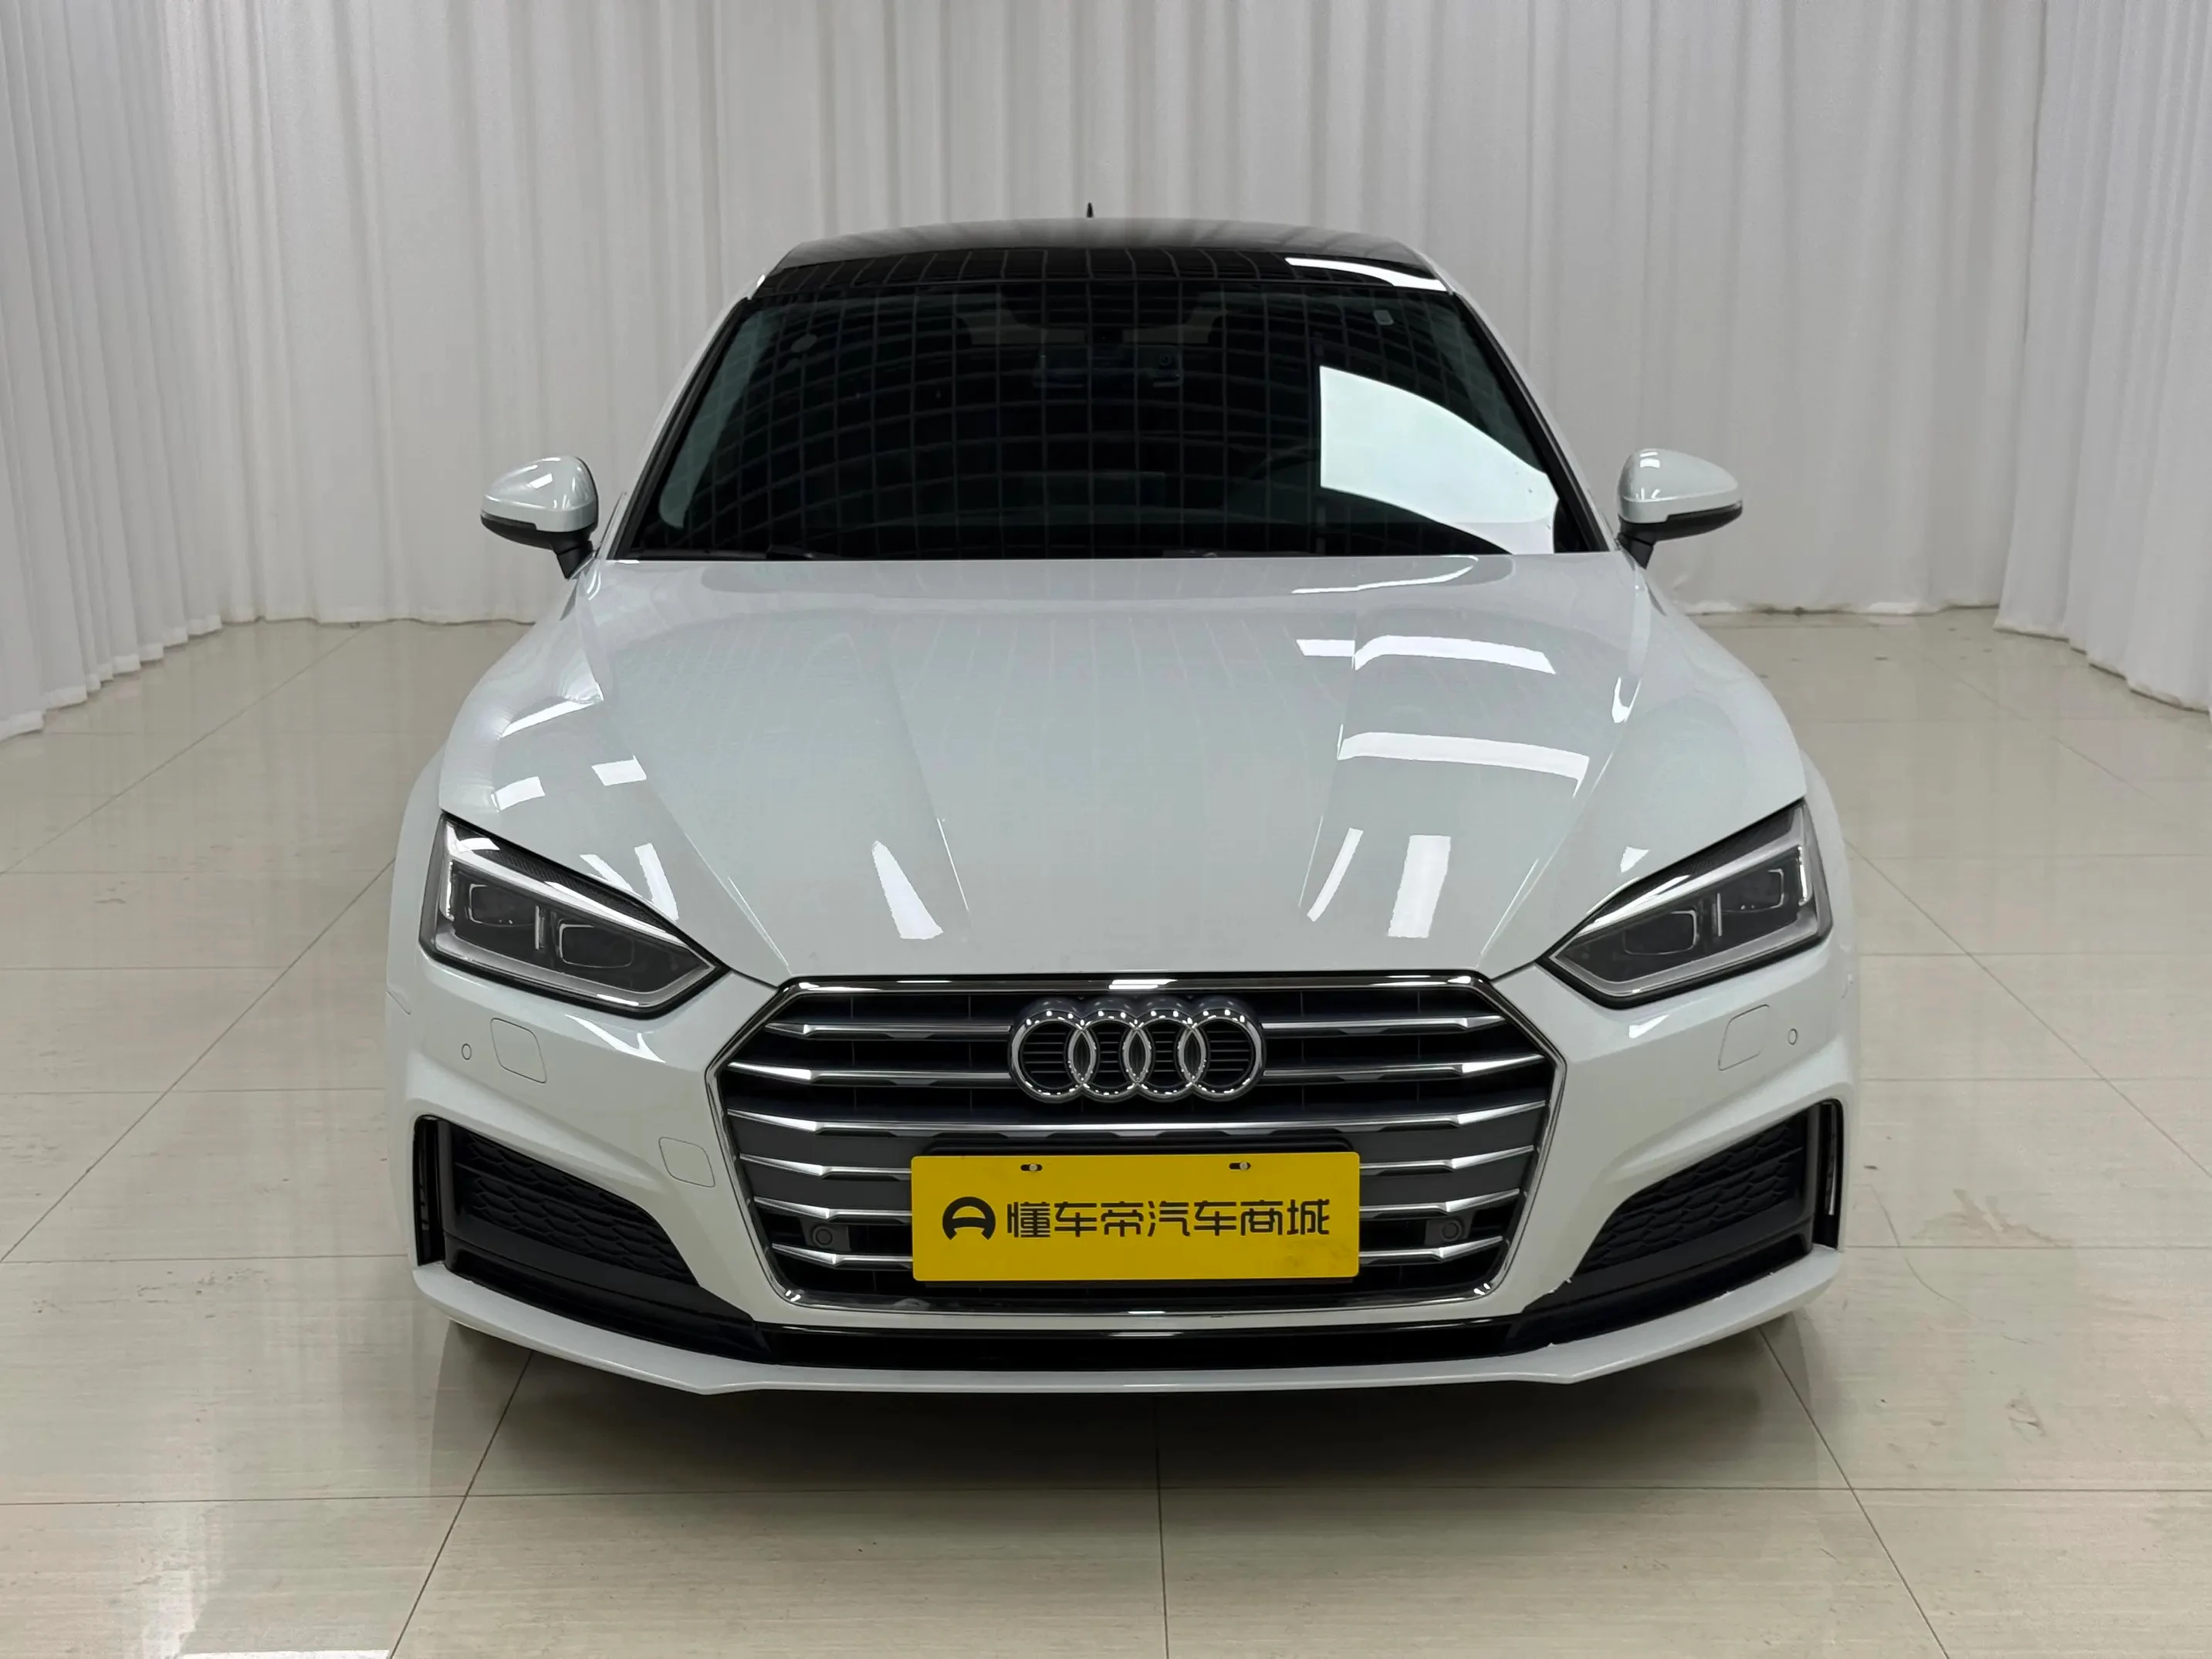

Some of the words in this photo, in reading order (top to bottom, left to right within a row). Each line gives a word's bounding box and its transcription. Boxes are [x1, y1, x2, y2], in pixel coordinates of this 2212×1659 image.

[1006, 1198, 1330, 1238] 懂车帝汽车商城
